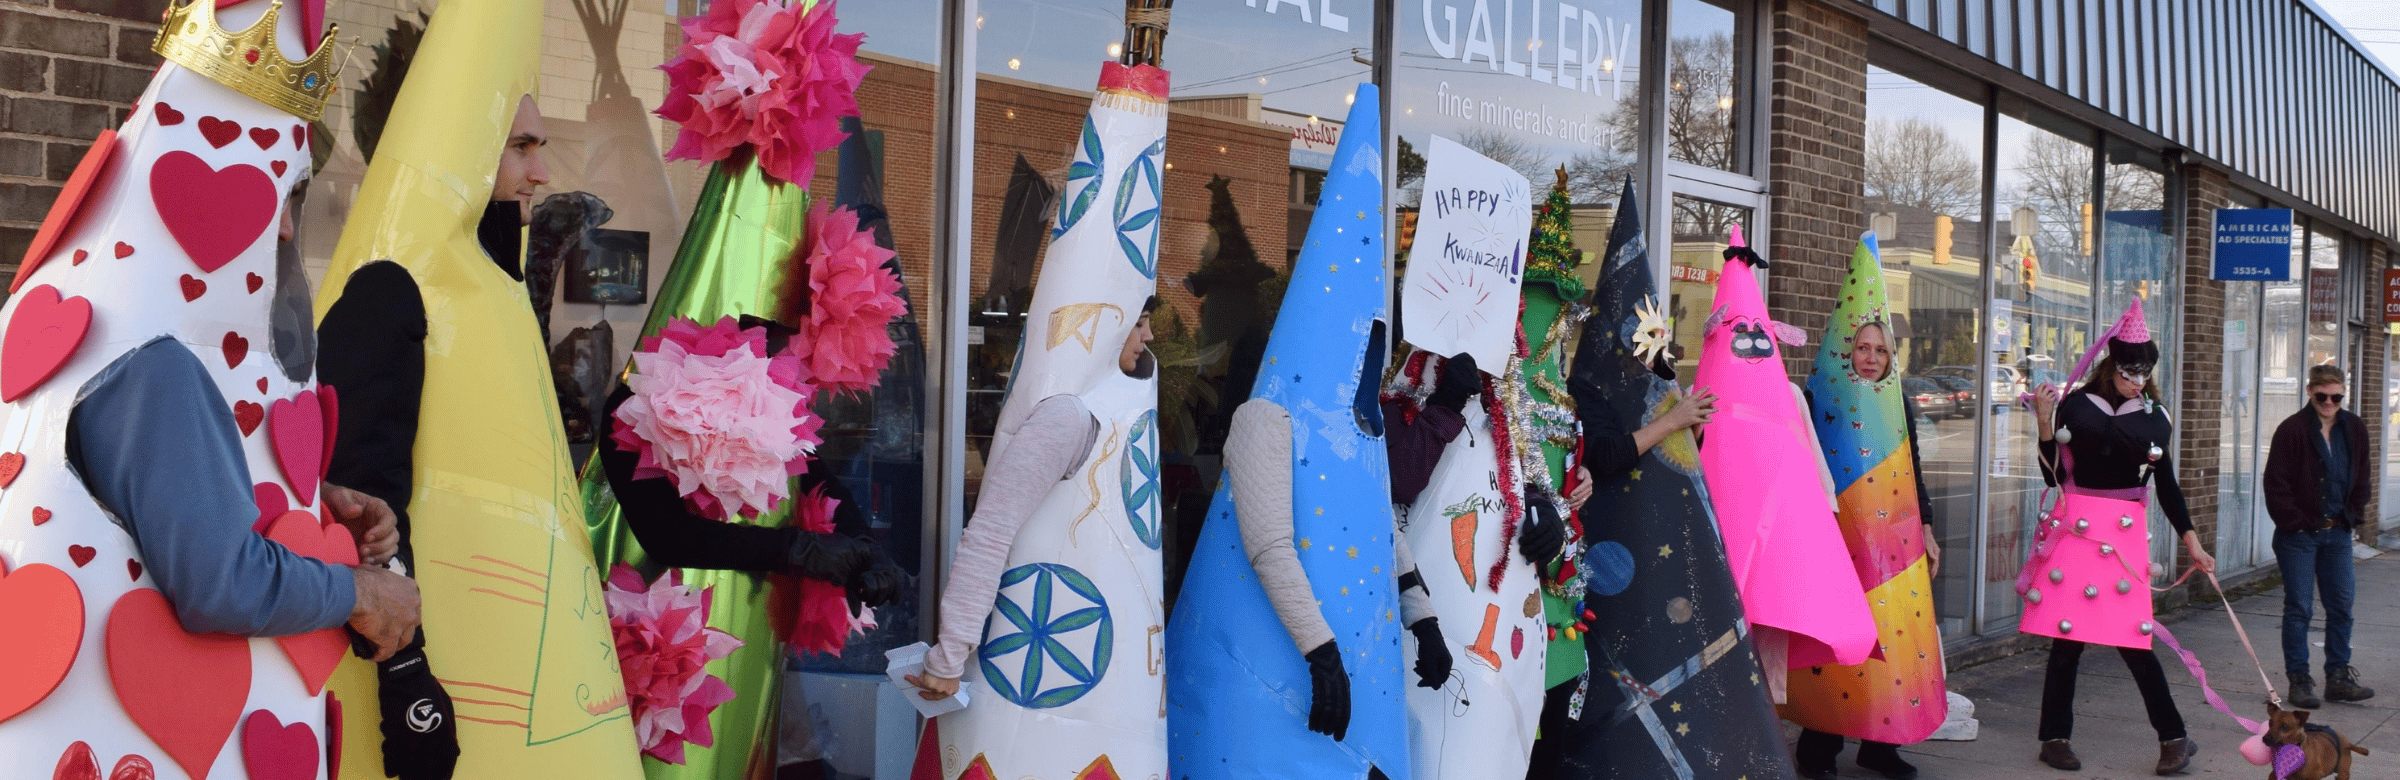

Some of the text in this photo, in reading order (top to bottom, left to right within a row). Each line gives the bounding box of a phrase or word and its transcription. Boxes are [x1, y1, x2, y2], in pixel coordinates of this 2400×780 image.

[1422, 0, 1631, 101] GALLERY
[1437, 81, 1617, 150] fine minerals and art
[1435, 187, 1499, 219] HAPPY
[2218, 224, 2290, 232] AMERICAN
[2218, 236, 2289, 244] AD SPECIALTIES
[2232, 267, 2271, 275] 3535-A
